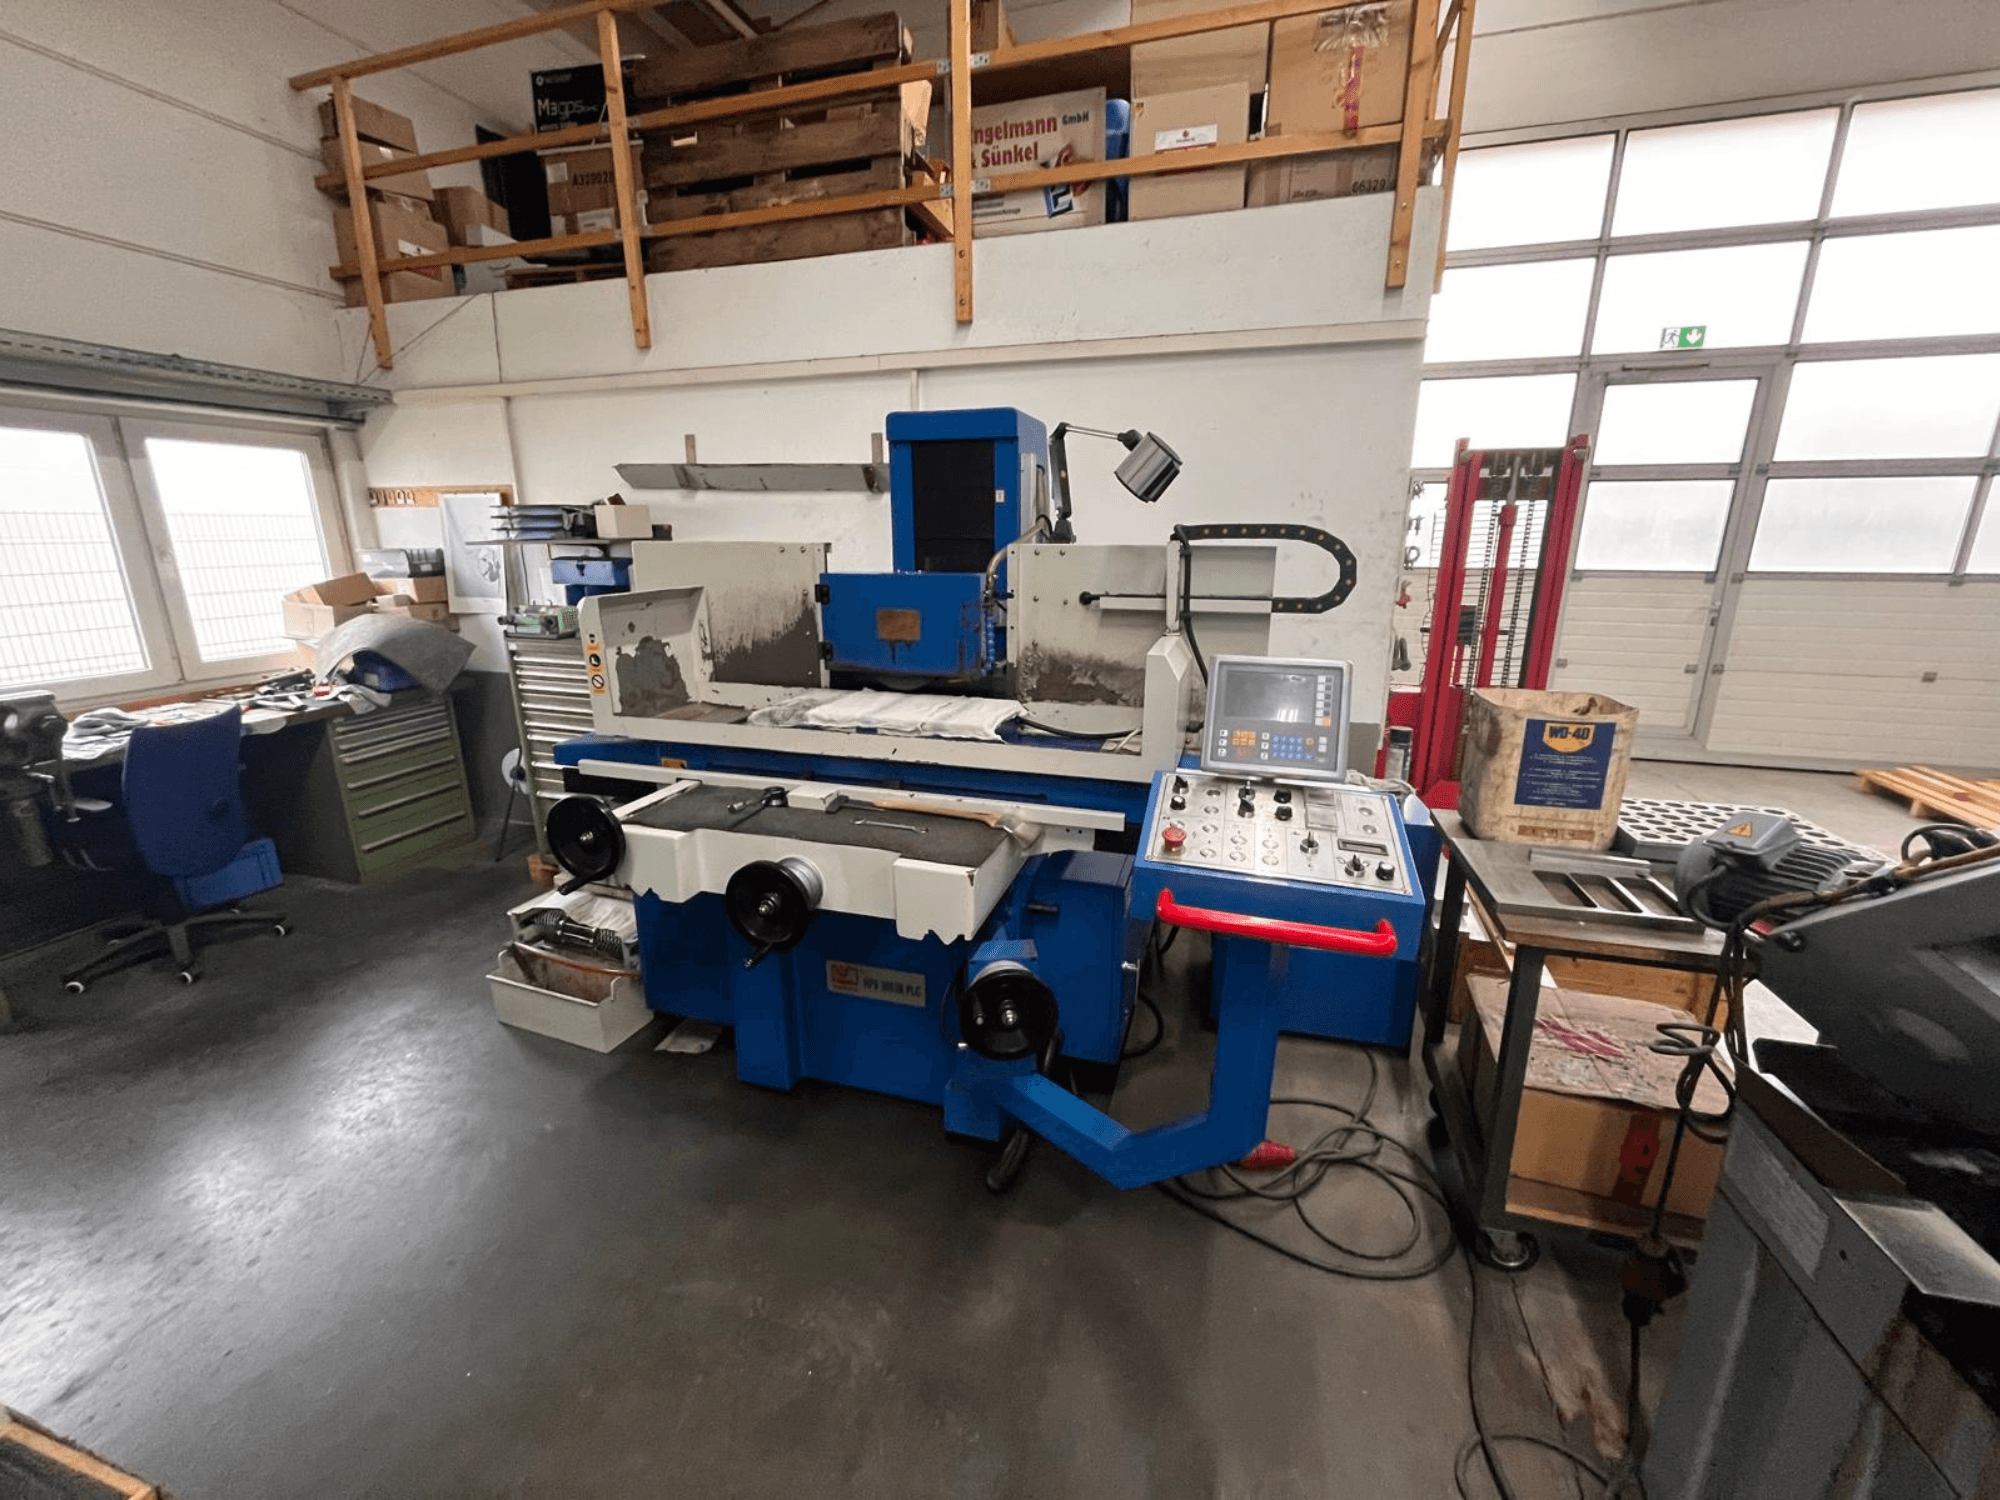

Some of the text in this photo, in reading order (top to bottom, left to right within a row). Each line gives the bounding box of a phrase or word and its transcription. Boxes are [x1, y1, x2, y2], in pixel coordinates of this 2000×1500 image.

[972, 110, 1090, 146] ngelmann GmbH
[981, 141, 1038, 168] Sünkel
[1549, 725, 1592, 740] WD-40
